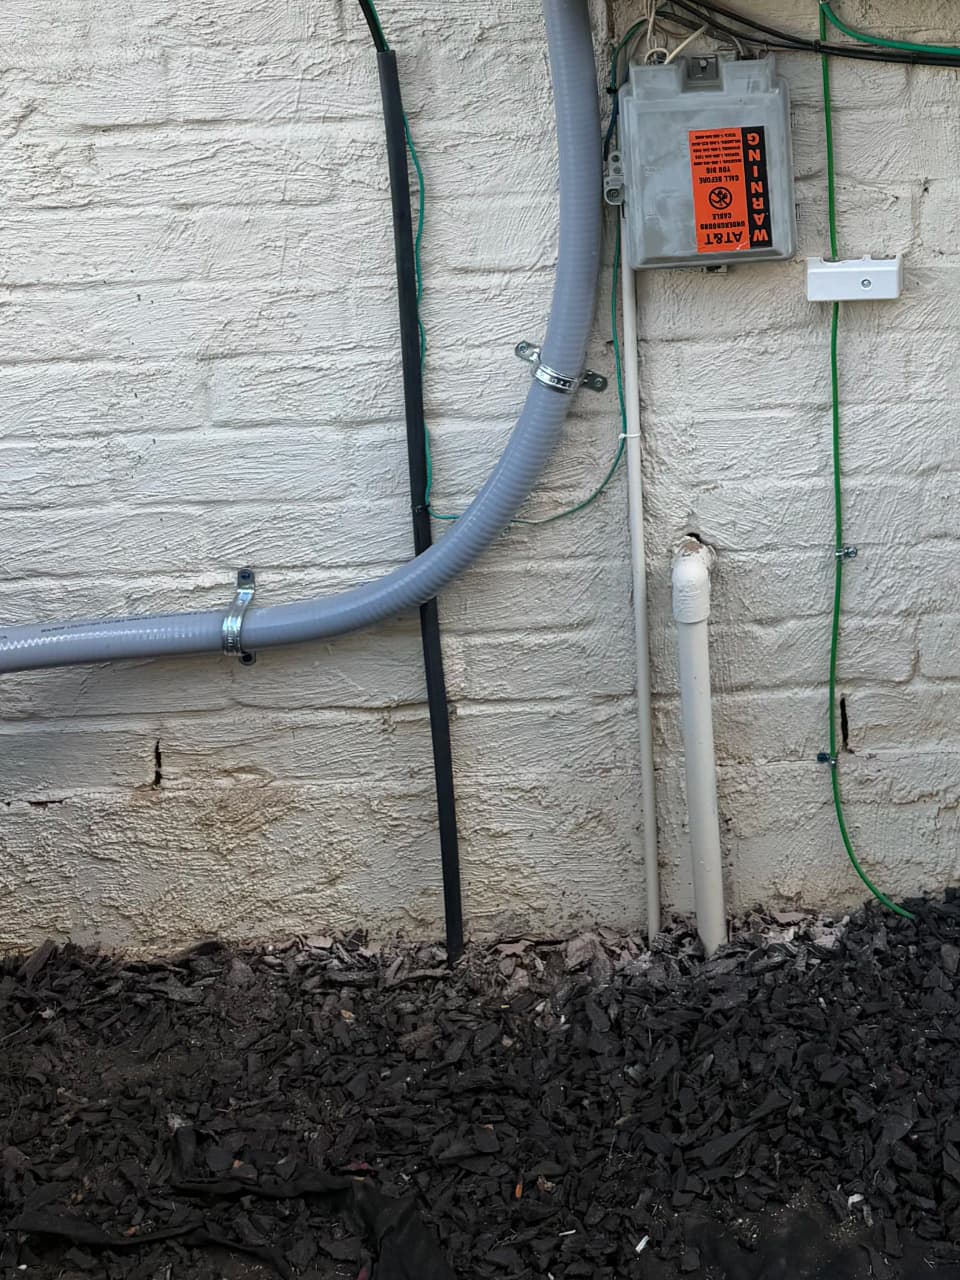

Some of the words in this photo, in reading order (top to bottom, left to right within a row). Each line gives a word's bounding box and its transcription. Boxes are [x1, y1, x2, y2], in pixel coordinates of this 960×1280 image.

[699, 176, 723, 184] BEFORE
[723, 175, 740, 183] CALL
[746, 132, 769, 242] WARNING
[700, 221, 746, 230] UNDERGROUND
[704, 230, 743, 246] AT&T
